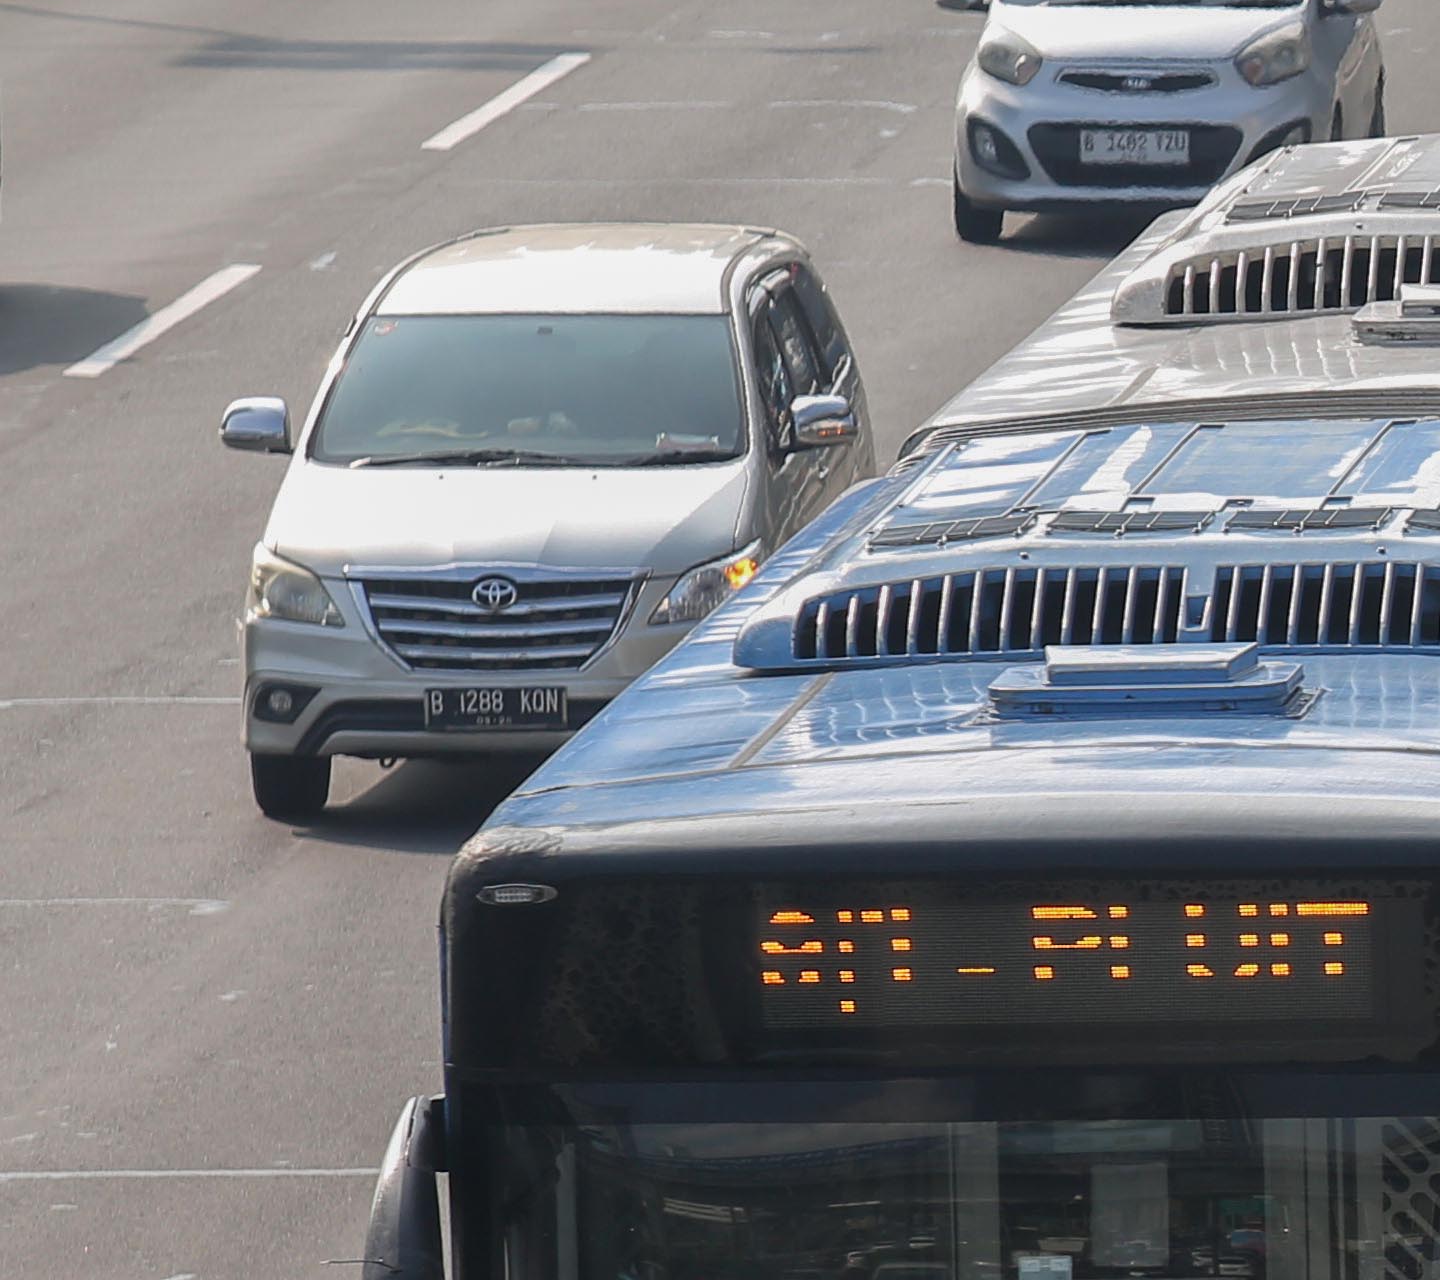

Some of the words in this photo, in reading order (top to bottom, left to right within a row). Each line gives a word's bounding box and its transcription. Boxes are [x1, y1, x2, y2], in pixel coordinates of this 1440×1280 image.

[1084, 133, 1094, 151] B
[431, 691, 444, 714] B
[459, 690, 505, 713] 1288
[520, 688, 559, 714] KQN
[1031, 902, 1373, 981] PLUIT
